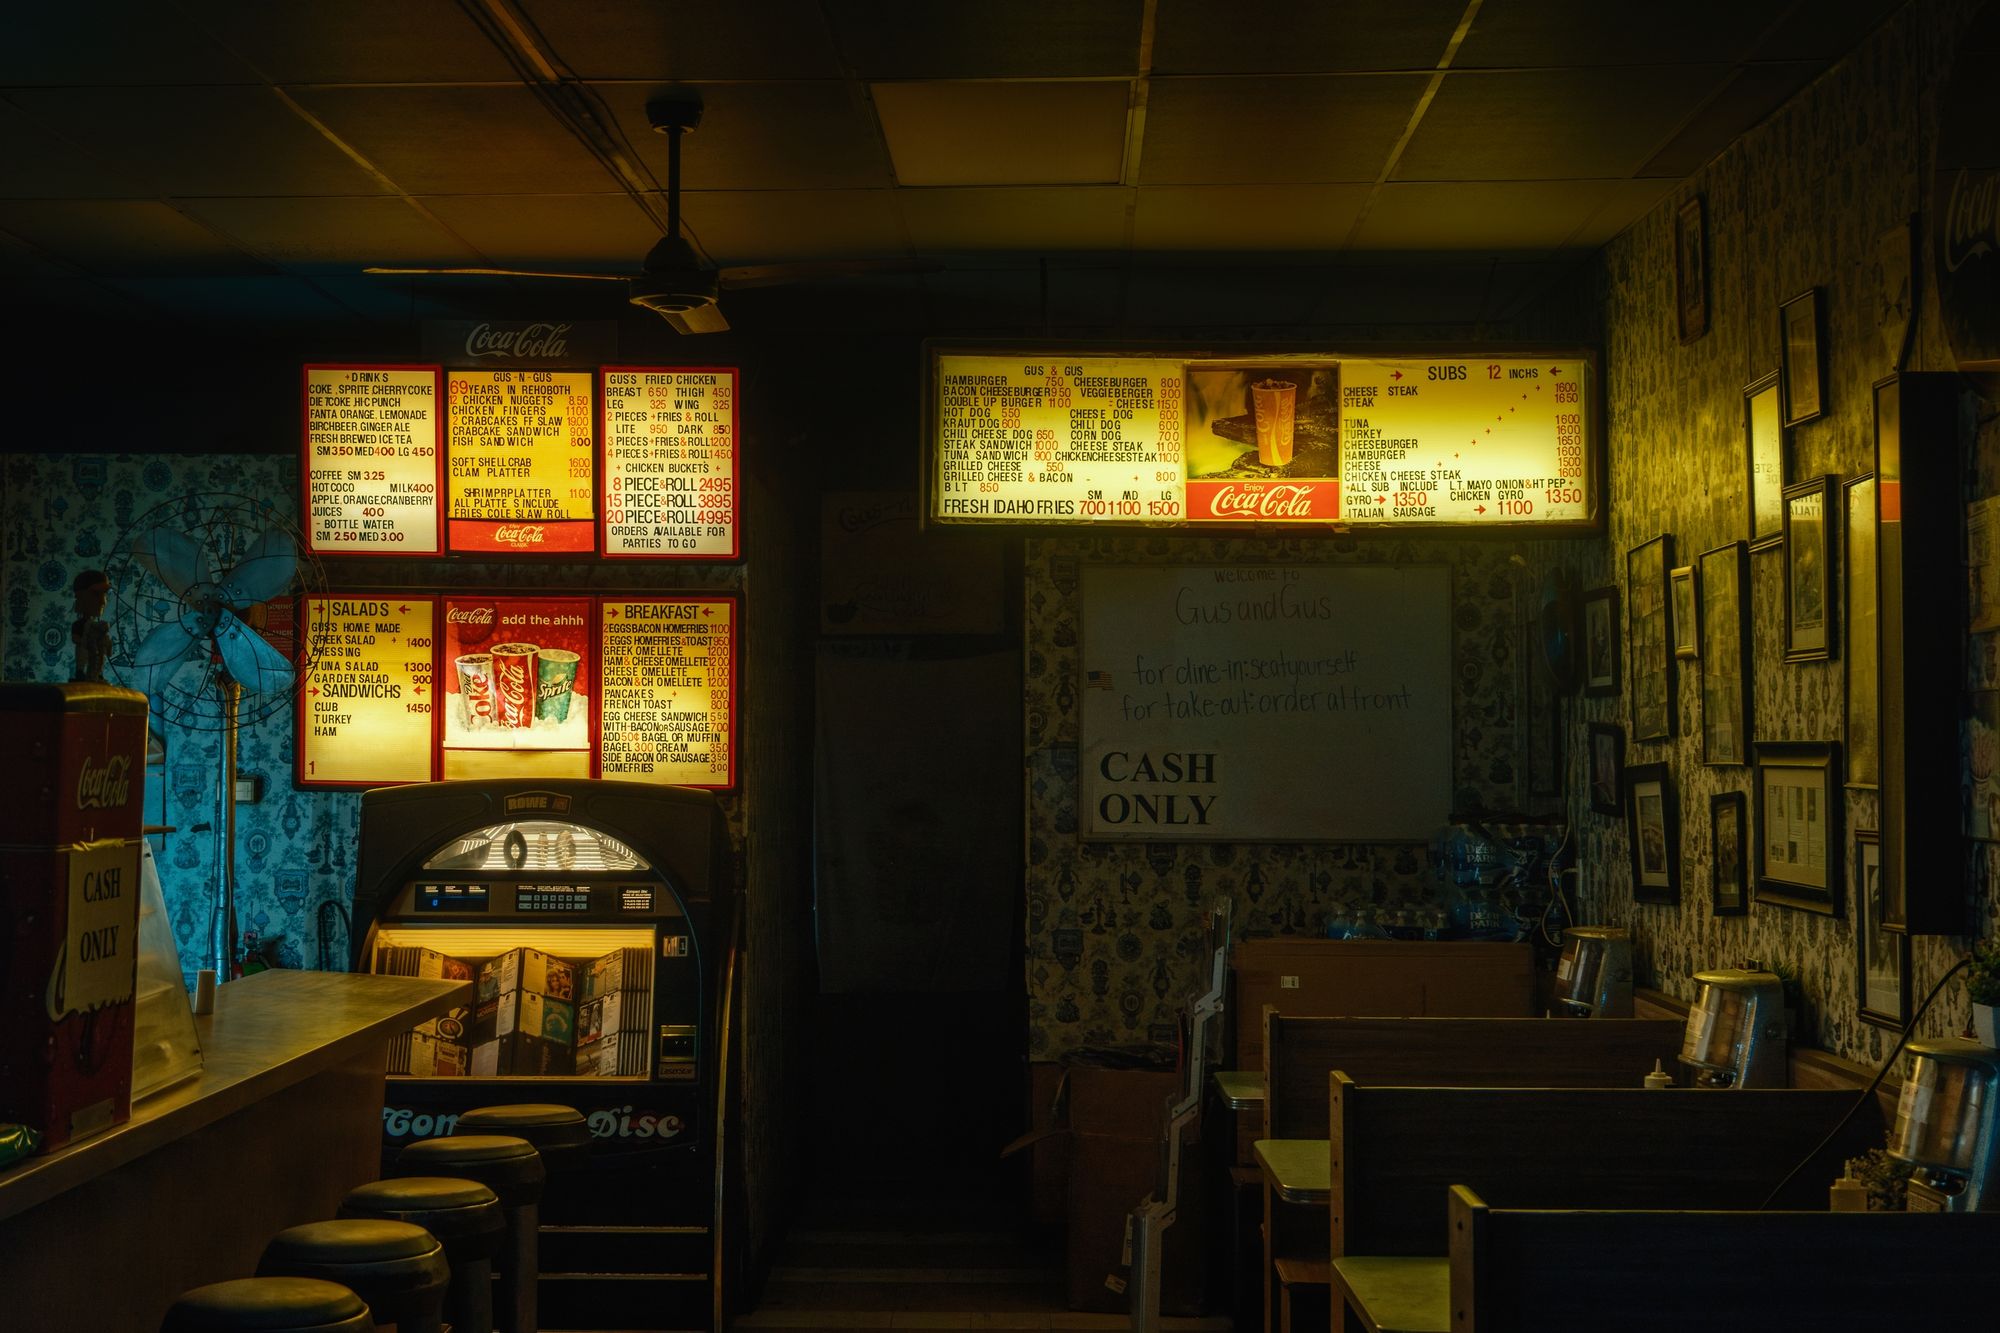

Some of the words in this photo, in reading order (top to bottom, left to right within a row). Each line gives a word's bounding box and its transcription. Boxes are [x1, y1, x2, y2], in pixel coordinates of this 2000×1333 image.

[465, 321, 576, 358] Coca-Cola
[1428, 366, 1467, 380] SUBS
[1487, 365, 1502, 380] 12
[1509, 368, 1539, 379] INCHS
[645, 375, 673, 385] FRIED
[676, 375, 717, 385] CHICKEN
[945, 376, 1008, 386] HAMBURGER
[1045, 377, 1064, 387] 750
[1074, 378, 1148, 388] CHEESEBURGER
[1161, 378, 1181, 388] 800
[468, 385, 500, 395] YEARS
[507, 385, 516, 395] IN
[522, 385, 571, 395] REHOBOTH
[606, 388, 642, 397] BREAST
[648, 388, 668, 397] 650
[676, 388, 705, 398] THIGH
[712, 388, 731, 398] 450
[1081, 388, 1153, 398] VEGGIEBERGER
[1161, 389, 1181, 399] 900
[463, 396, 503, 405] CHICKEN
[511, 396, 553, 405] NUGGETS
[310, 410, 337, 419] FANTA
[380, 410, 427, 420] LEMONADE
[452, 406, 495, 416] CHICKEN
[503, 406, 547, 416] FINGERS
[566, 406, 589, 416] 1100
[616, 425, 636, 434] LITE
[650, 424, 668, 434] 950
[678, 425, 704, 434] DARK
[713, 425, 731, 435] 850
[1070, 420, 1095, 430] CHILI
[1101, 420, 1121, 430] DOG
[1159, 421, 1179, 430] 600
[310, 434, 338, 443] FRESH
[340, 434, 377, 444] BREWED
[379, 435, 394, 444] ICE
[395, 435, 412, 444] TEA
[1071, 431, 1097, 440] CORN
[1102, 431, 1121, 441] DOG
[1160, 432, 1179, 441] 700
[1345, 450, 1406, 460] HAMBURGER
[1557, 446, 1581, 457] 1600
[452, 458, 476, 467] SOFT
[478, 458, 507, 467] SHELL
[508, 458, 532, 467] CRAB
[569, 458, 591, 468] 1600
[944, 461, 983, 471] GRILLED
[988, 462, 1022, 471] CHEESE
[1046, 462, 1064, 472] 550
[310, 471, 342, 480] COFFEE
[348, 471, 361, 480] SM
[453, 468, 480, 477] CLAM
[488, 468, 530, 478] PLATTER
[569, 468, 591, 478] 1200
[1345, 472, 1387, 482] CHICKEN
[1391, 471, 1426, 481] CHEESE
[1431, 470, 1461, 480] STEAK
[1559, 468, 1582, 478] 1600
[613, 477, 622, 491] 8
[699, 478, 732, 492] 2495
[1244, 484, 1264, 492] Enjoy
[607, 494, 622, 507] 15
[698, 494, 732, 508] 3895
[1210, 485, 1316, 517] Coca-Cola
[1346, 495, 1372, 505] GYRO
[1392, 492, 1427, 507] 1350
[1498, 490, 1524, 500] GYRO
[1545, 489, 1582, 504] 1350
[312, 507, 342, 517] JUICES
[363, 508, 385, 517] 400
[945, 499, 989, 514] FRESH
[994, 500, 1034, 514] IDAHO
[1038, 500, 1074, 515] FRIES
[1080, 501, 1106, 515] 700
[1108, 501, 1142, 516] 1100
[1147, 501, 1180, 516] 1500
[1393, 507, 1436, 517] SAUSAGE
[1498, 501, 1533, 515] 1100
[607, 510, 624, 524] 20
[325, 520, 359, 529] BOTTLE
[363, 520, 394, 529] WATER
[495, 524, 545, 543] Coca-Cola
[612, 526, 648, 536] ORDERS
[654, 527, 702, 536] AVAILABLE
[707, 527, 726, 536] FOR
[623, 539, 661, 548] PARTIES
[668, 539, 679, 548] TO
[332, 602, 389, 617] SALADS
[1176, 586, 1232, 625] Gus
[1280, 584, 1331, 620] Gus
[446, 608, 495, 625] Coca-Cola
[625, 605, 699, 619] BREAKFAST
[502, 615, 526, 625] add
[530, 615, 551, 625] the
[554, 615, 584, 626] ahhh
[343, 623, 370, 633] HOME
[375, 623, 401, 633] MADE
[604, 646, 633, 656] GREEK
[636, 647, 683, 656] OMELLETE
[708, 647, 729, 657] 1200
[604, 667, 638, 676] CHEESE
[642, 667, 687, 677] OMELLETE
[706, 668, 729, 677] 1100
[1132, 654, 1173, 685] for
[314, 674, 356, 683] GARDEN
[359, 674, 389, 684] SALAD
[412, 675, 432, 685] 900
[323, 684, 401, 699] SANDWICHS
[538, 680, 572, 700] Sprite
[604, 689, 654, 699] PANCAKES
[711, 690, 728, 699] 800
[314, 702, 338, 712] CLUB
[406, 704, 431, 713] 1450
[604, 700, 640, 709] FRENCH
[644, 700, 673, 710] TOAST
[1120, 694, 1163, 721] for
[314, 715, 352, 724] TURKEY
[314, 727, 337, 737] HAM
[603, 743, 632, 752] BAGEL
[634, 743, 653, 752] 300
[656, 743, 689, 753] CREAM
[710, 743, 728, 753] 350
[603, 763, 654, 773] HOMEFRIES
[710, 763, 728, 774] 300
[1100, 751, 1218, 784] CASH
[76, 752, 133, 810] Coca-Cola
[1100, 794, 1217, 826] ONLY
[84, 868, 122, 903] CASH
[80, 925, 120, 963] ONLY
[586, 1105, 681, 1138] Disc
